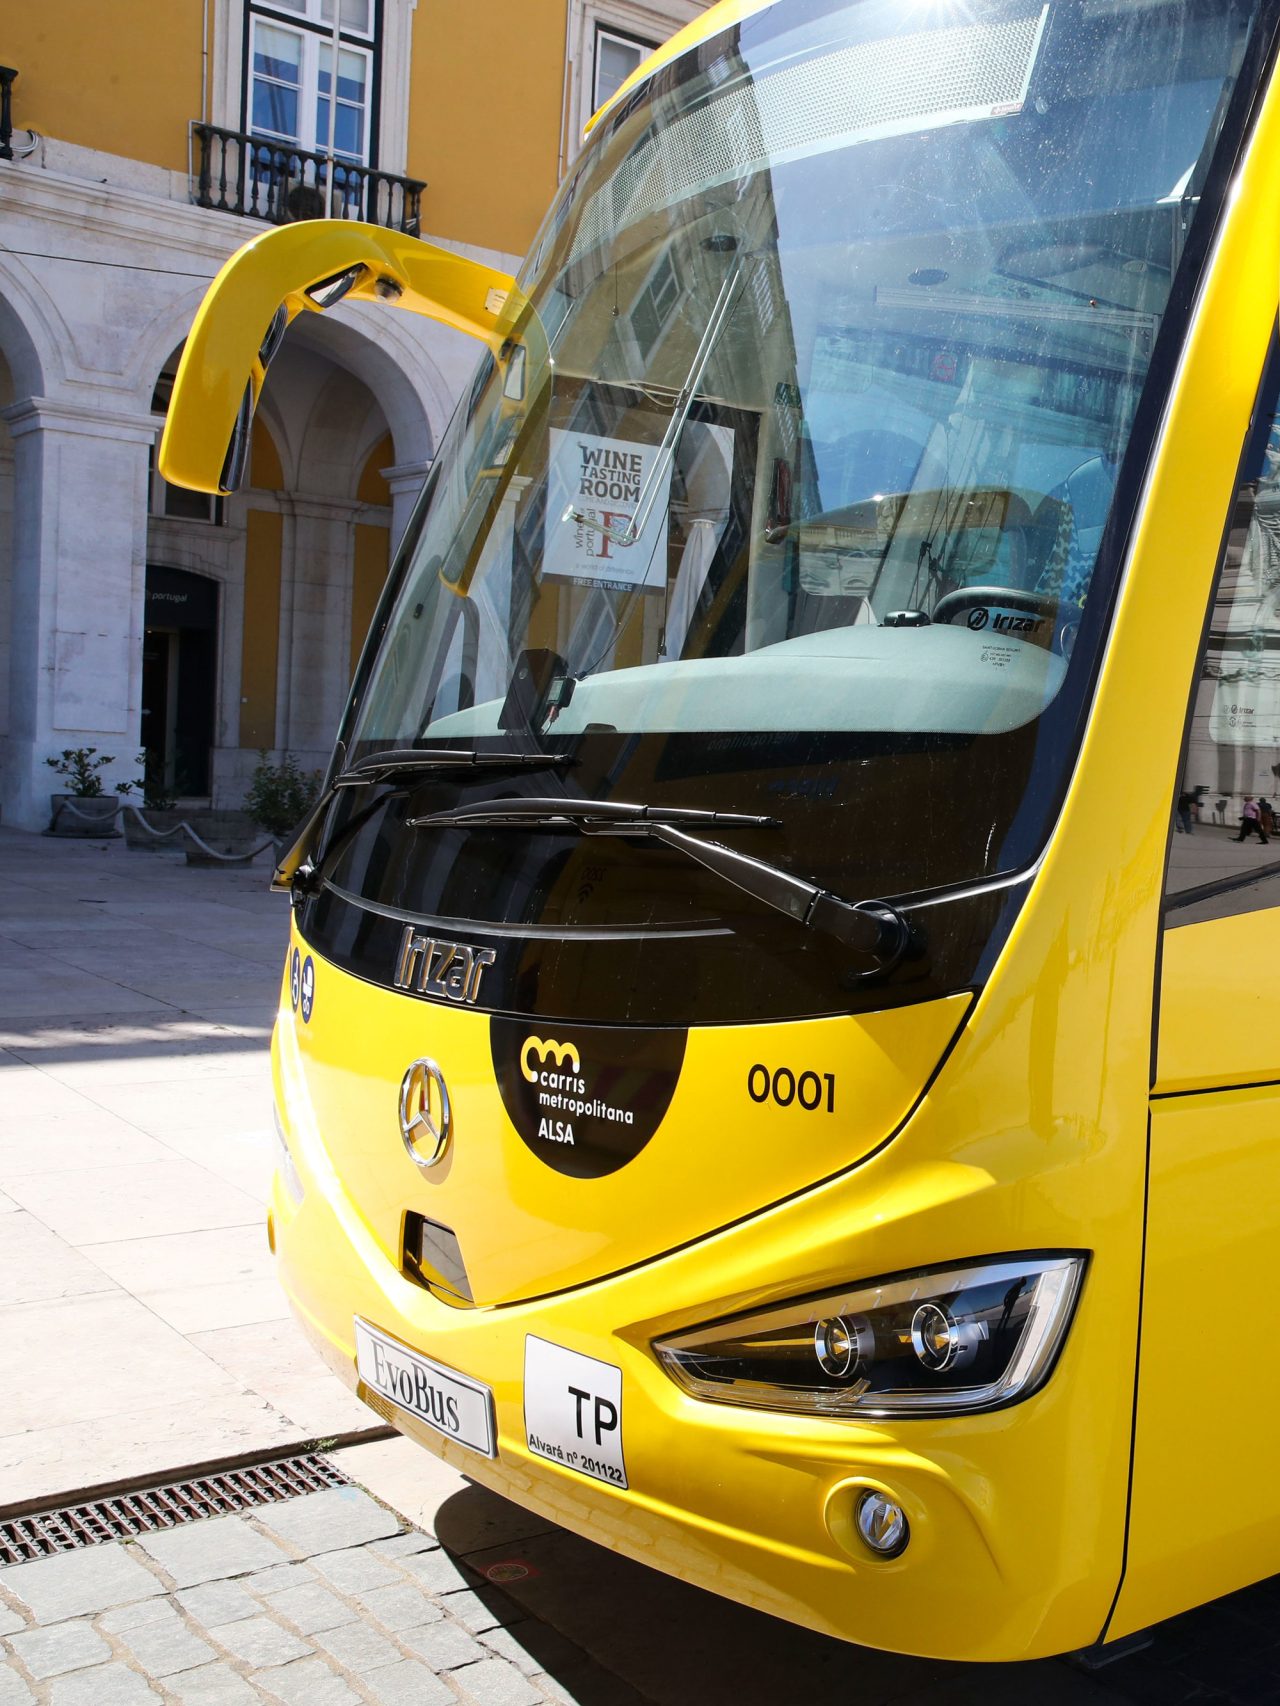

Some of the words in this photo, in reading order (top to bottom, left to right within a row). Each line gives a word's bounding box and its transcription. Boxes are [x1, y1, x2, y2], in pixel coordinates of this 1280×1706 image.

[578, 442, 642, 474] WINE
[579, 478, 640, 503] ROOM
[580, 465, 641, 486] TASTING
[151, 592, 188, 603] portugal
[573, 576, 592, 587] FREE
[592, 579, 633, 592] ENTRANCE
[992, 613, 1046, 632] Irizar
[393, 926, 496, 1004] Irizar
[540, 1071, 585, 1094] carris
[747, 1063, 835, 1113] 0001
[539, 1092, 634, 1125] metropolitana
[538, 1117, 574, 1145] ALSA
[371, 1338, 460, 1433] EvoBus
[567, 1385, 618, 1446] TP
[529, 1433, 563, 1460] Alvará
[581, 1455, 624, 1483] 201122
